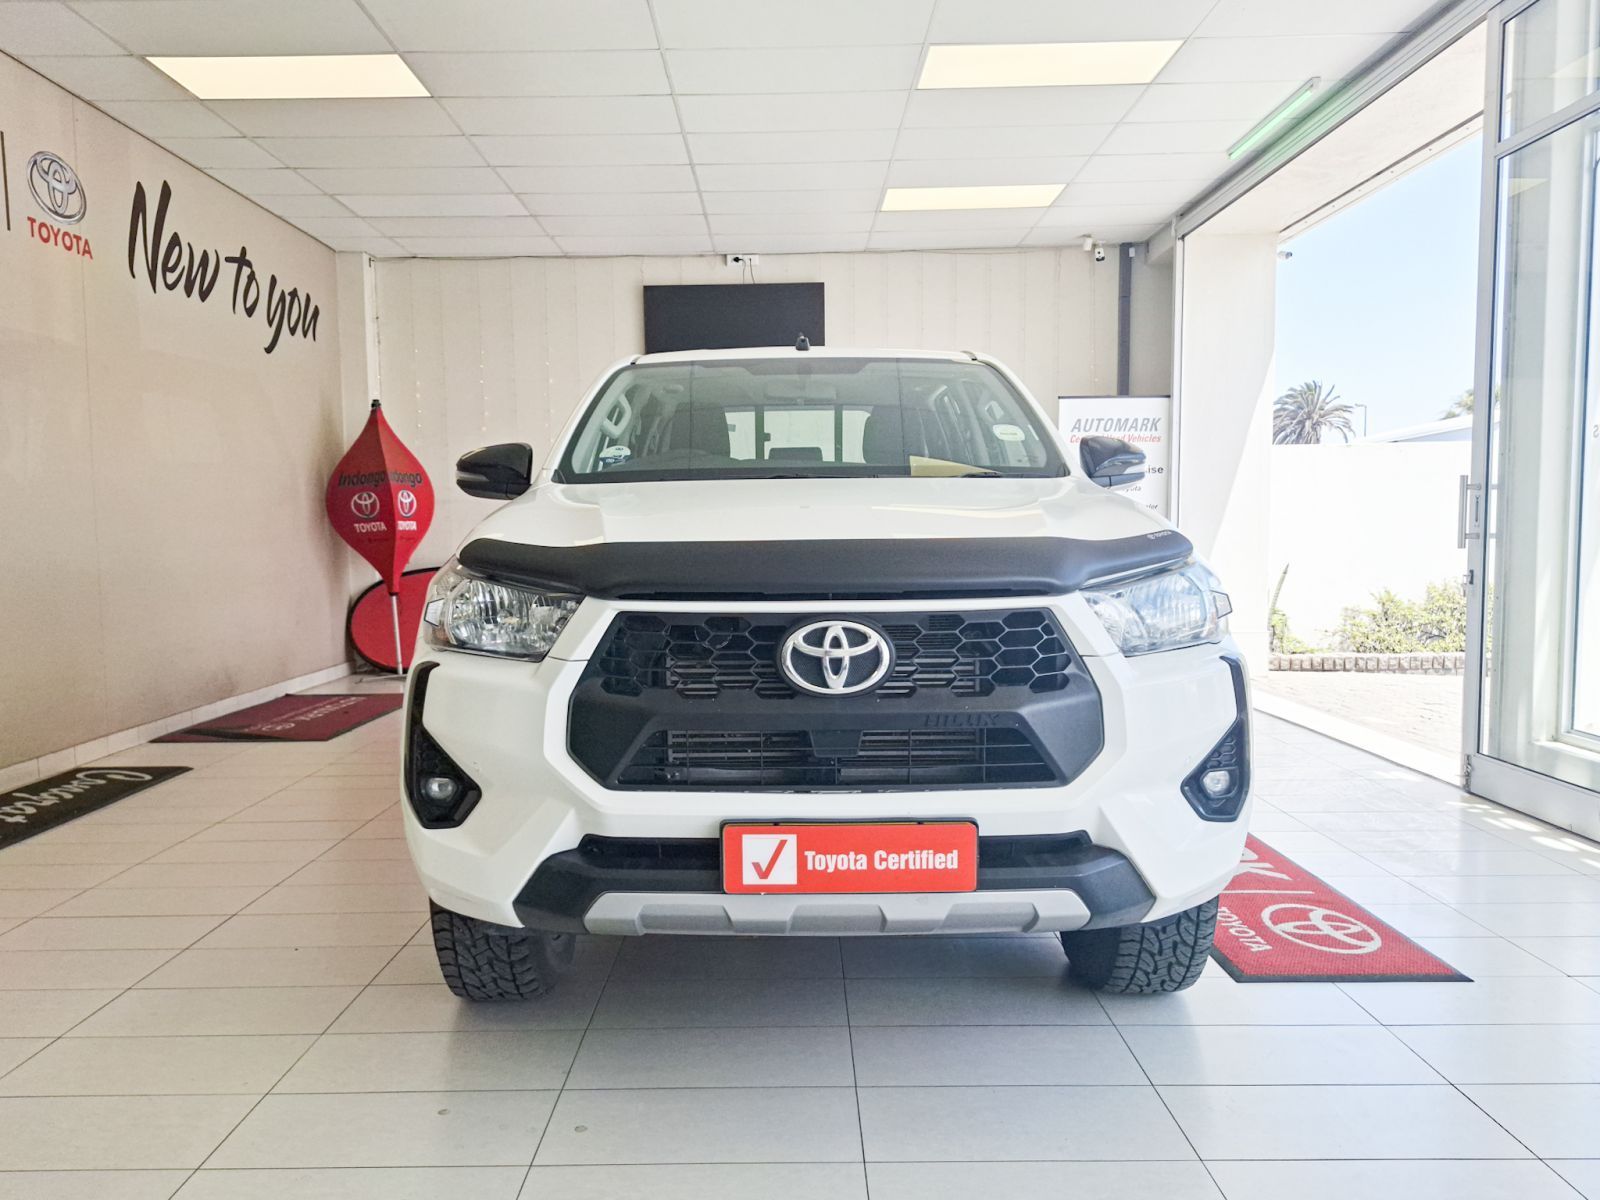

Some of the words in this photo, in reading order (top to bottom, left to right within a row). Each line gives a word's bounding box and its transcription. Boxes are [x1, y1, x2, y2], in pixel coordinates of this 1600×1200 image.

[27, 216, 94, 260] TOYOTA
[128, 180, 220, 303] New
[224, 246, 260, 318] to
[263, 274, 320, 354] you
[1070, 417, 1162, 433] AUTOMARK
[1126, 433, 1162, 443] Vehicles
[353, 521, 388, 533] TOYOTA
[397, 520, 417, 531] TOYOTA
[923, 713, 1000, 727] HILUX
[804, 850, 868, 871] Toyota
[874, 849, 959, 870] Certified
